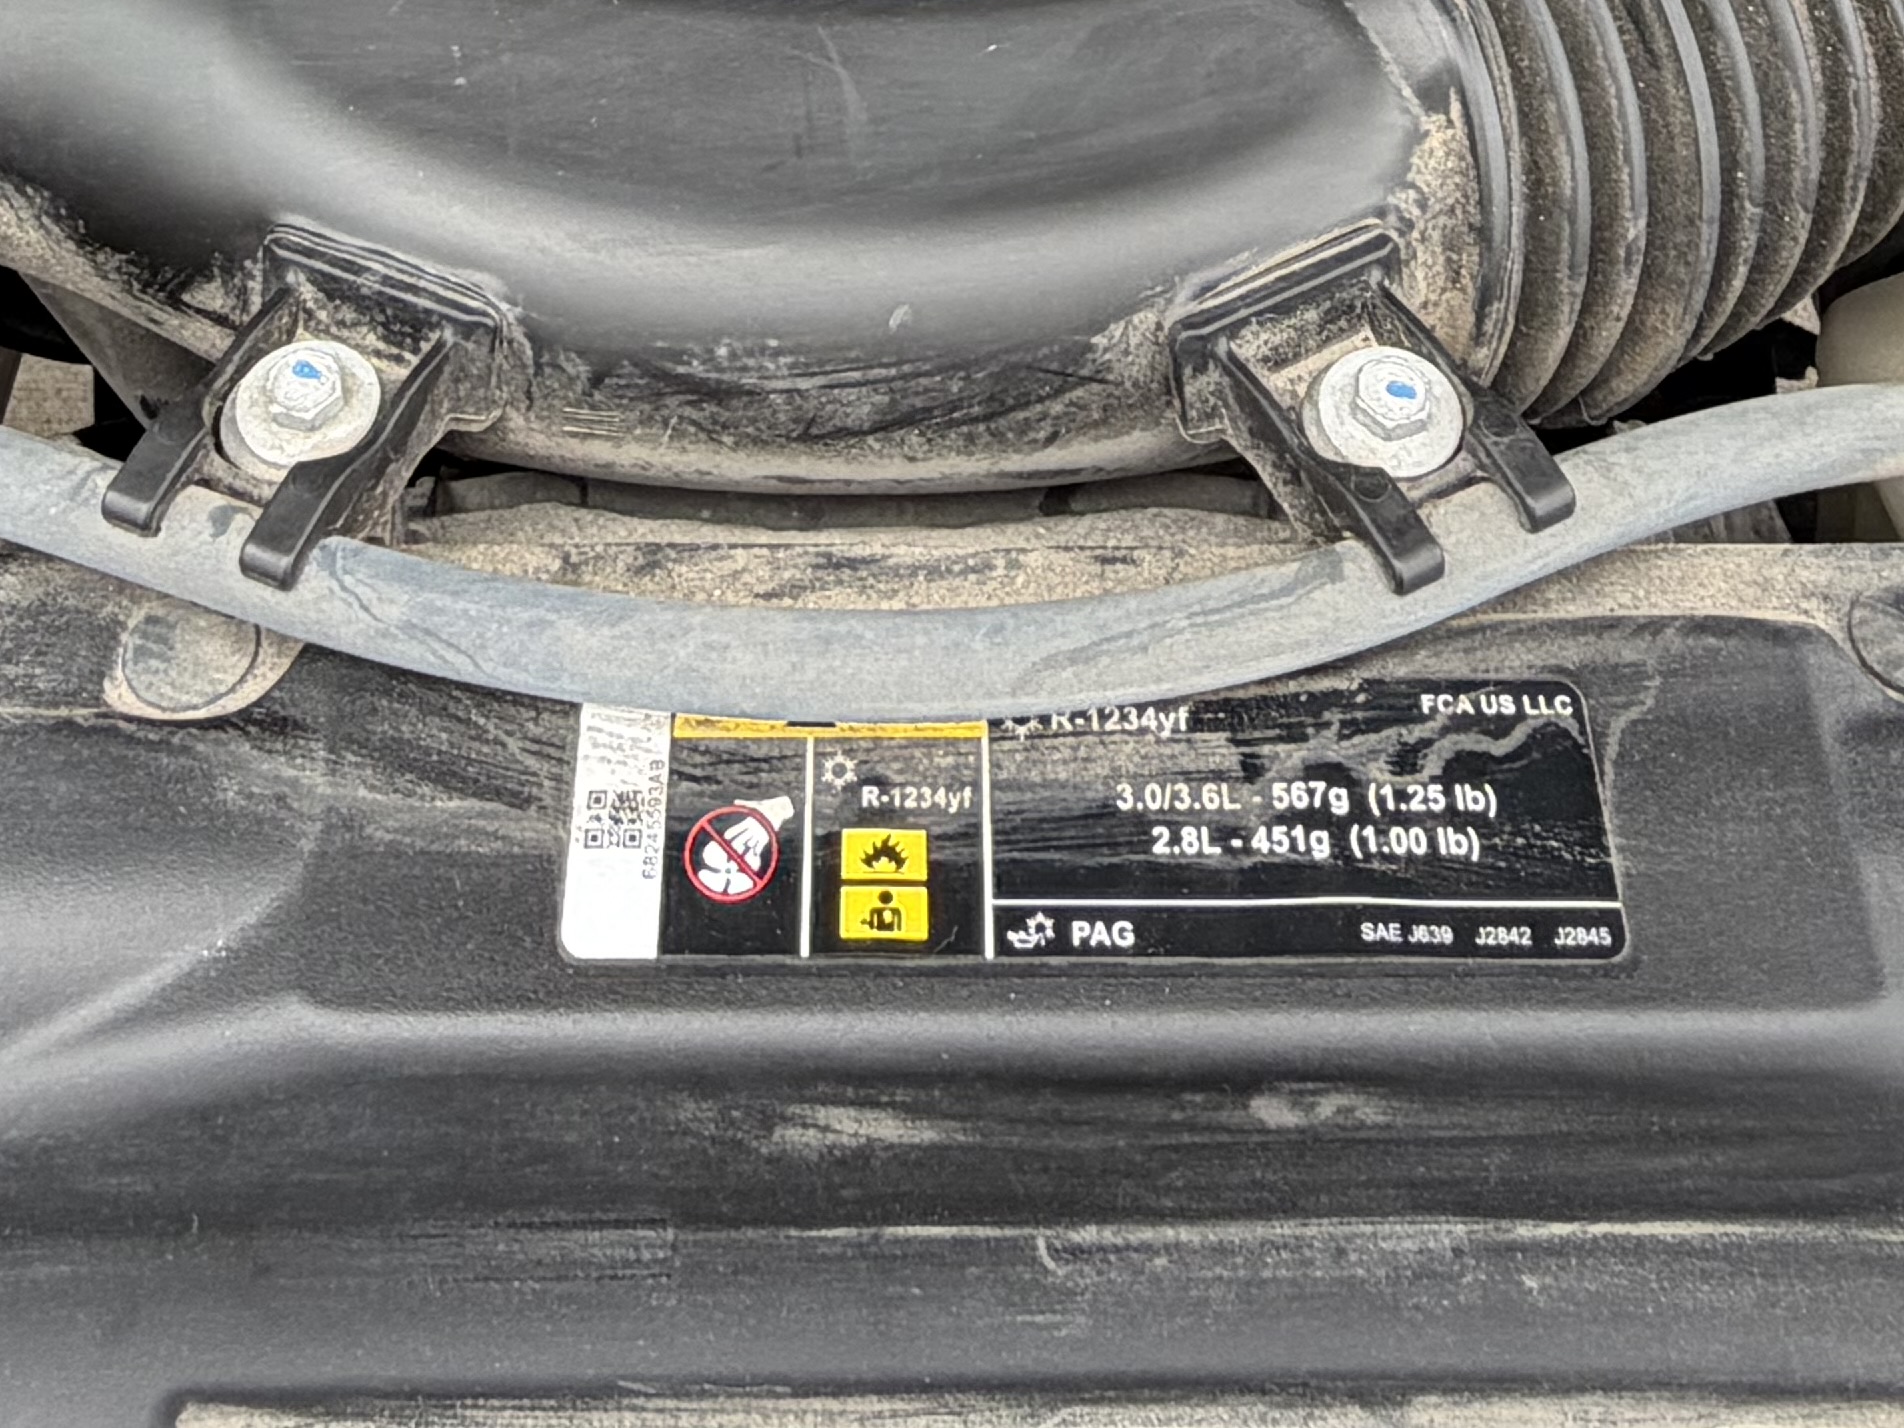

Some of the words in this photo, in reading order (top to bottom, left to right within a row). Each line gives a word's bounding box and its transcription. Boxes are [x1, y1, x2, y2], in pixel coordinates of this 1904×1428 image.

[1420, 694, 1475, 716] FCA
[1480, 695, 1516, 716] US
[1523, 694, 1574, 717] LLC
[861, 785, 973, 815] R-1234yf
[1114, 783, 1242, 812] 3.0/3.6L
[1271, 781, 1350, 816] 567g
[1368, 783, 1446, 818] (1.25
[1454, 783, 1497, 818] lb)
[1151, 826, 1222, 856] 2.8L
[1250, 825, 1330, 860] 451g
[1350, 824, 1428, 860] (1.00
[1436, 826, 1480, 863] lb)
[1070, 920, 1136, 948] PAG
[1360, 922, 1404, 943] SAE
[1407, 924, 1455, 946] J639
[1475, 926, 1533, 947] J2842
[1554, 927, 1613, 948] J2845
